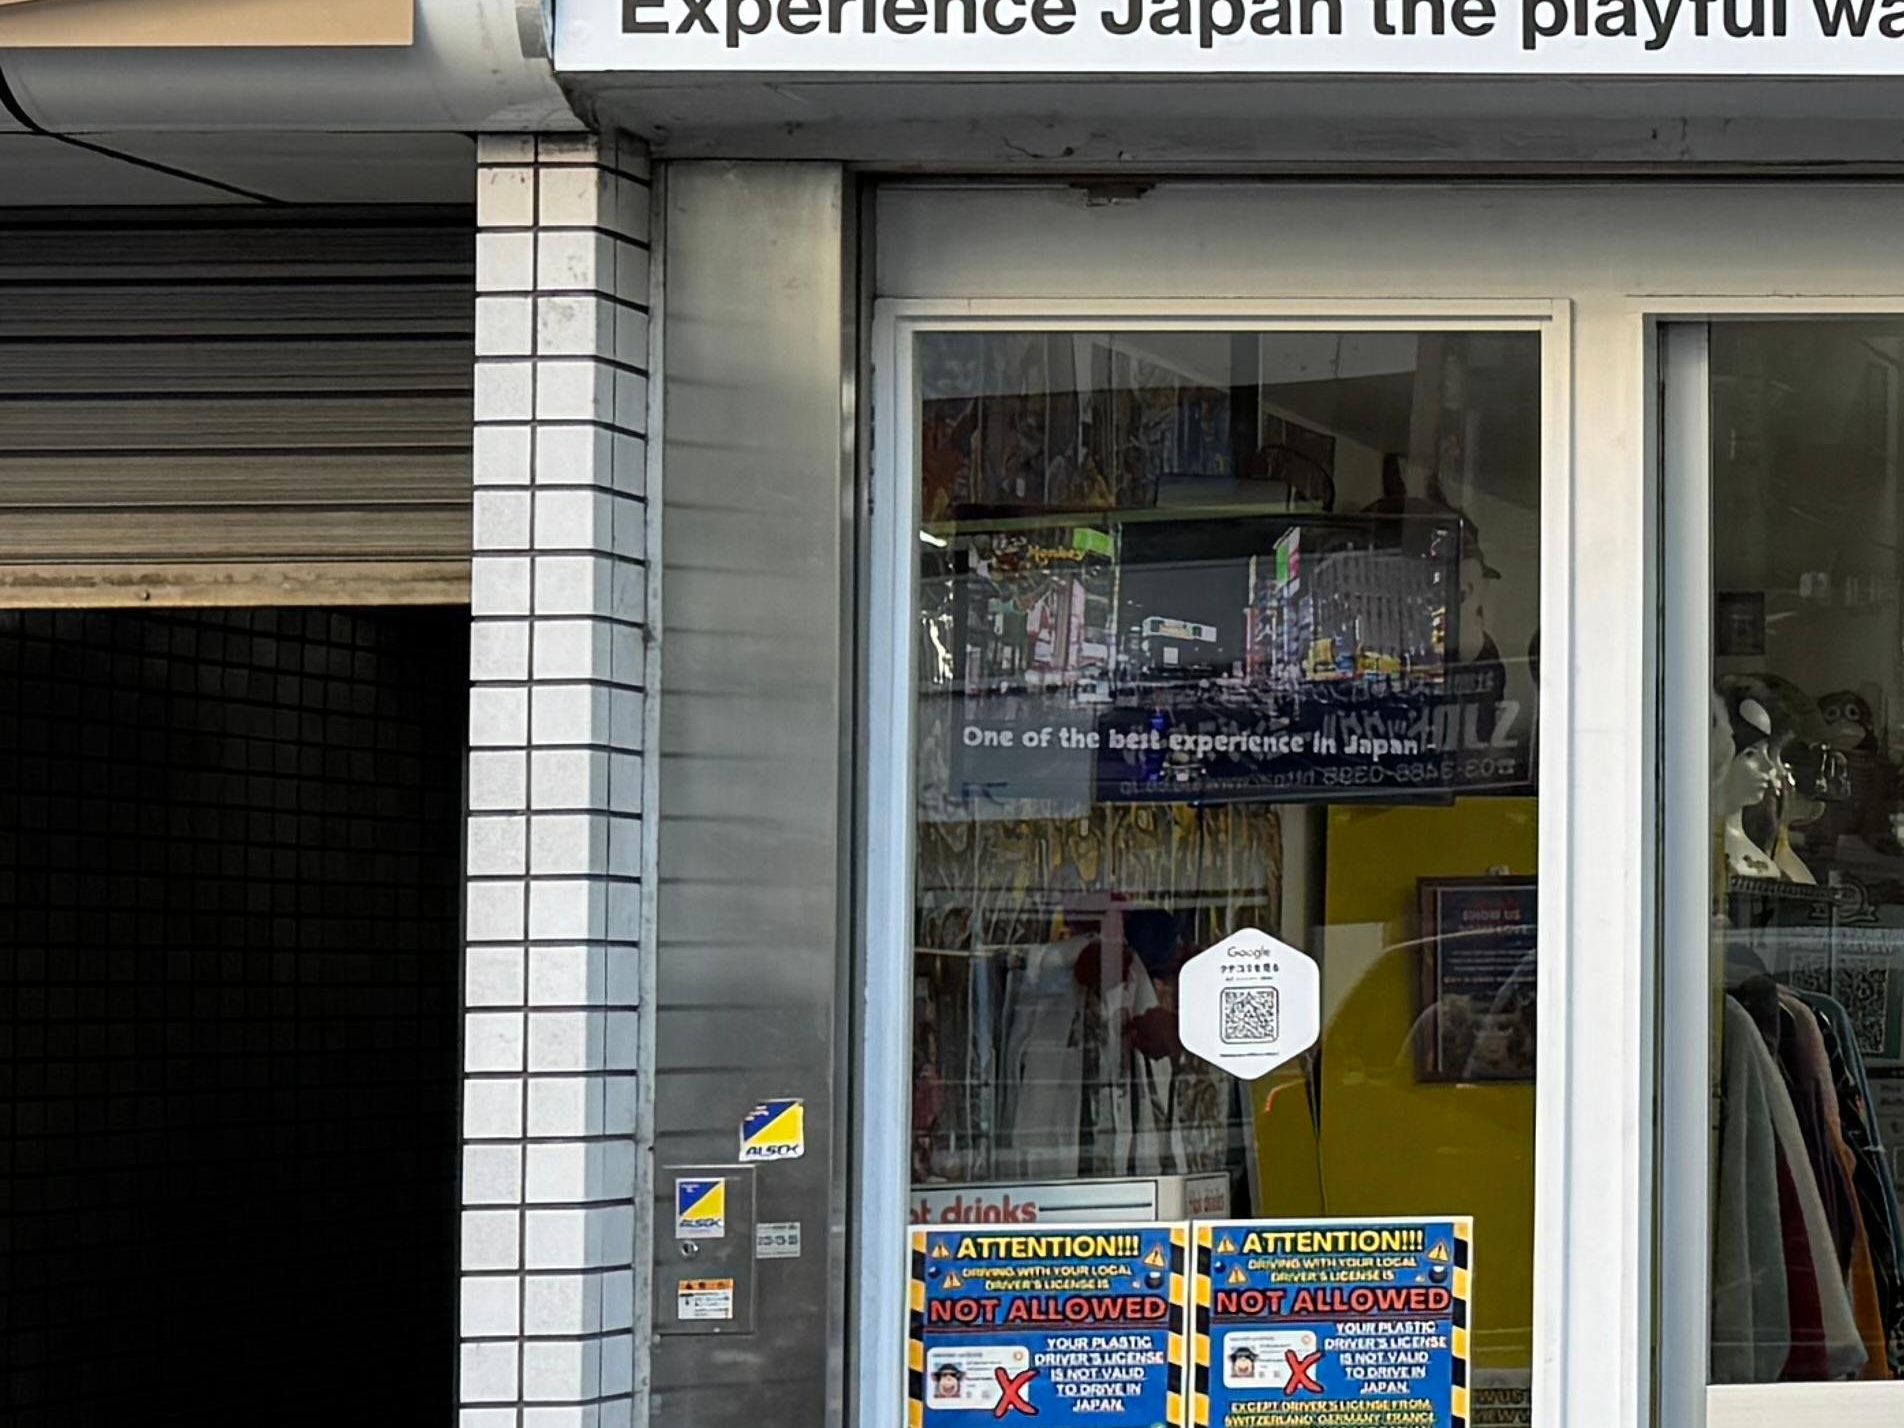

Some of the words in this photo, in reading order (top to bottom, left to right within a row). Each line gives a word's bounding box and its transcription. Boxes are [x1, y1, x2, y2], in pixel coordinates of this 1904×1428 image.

[962, 726, 1013, 748] One
[1022, 727, 1055, 748] of
[1059, 727, 1100, 749] the
[1109, 728, 1161, 751] best
[1169, 728, 1304, 755] experience
[1314, 731, 1337, 754] in
[1344, 735, 1418, 760] Japan
[1227, 945, 1271, 960] Google
[745, 1144, 799, 1157] ALSOK
[951, 1195, 1038, 1223] drinks
[957, 1235, 1140, 1259] ATTENTION!!!
[1242, 1230, 1423, 1254] ATTENTION!!!
[1302, 1258, 1335, 1269] WITH
[1338, 1257, 1374, 1268] YOUR
[1376, 1256, 1417, 1267] LOCAL
[963, 1267, 1015, 1277] DRIVING
[1017, 1266, 1049, 1277] WITH
[1053, 1265, 1089, 1276] YOUR
[1091, 1264, 1132, 1276] LOCAL
[1382, 1271, 1394, 1280] IS
[1045, 1279, 1096, 1290] LICENSE
[1097, 1279, 1109, 1289] IS
[1216, 1290, 1284, 1313] NOT
[1293, 1288, 1450, 1312] ALLOWED
[930, 1299, 999, 1322] NOT
[1008, 1296, 1166, 1320] ALLOWED
[1336, 1322, 1376, 1335] YOUR
[1378, 1321, 1437, 1334] PLASTIC
[1047, 1338, 1088, 1350] YOUR
[1092, 1336, 1152, 1349] PLASTIC
[1324, 1338, 1388, 1351] DRIVER'S
[1390, 1336, 1447, 1349] LICENSE
[1034, 1353, 1101, 1365] DRIVER'S
[1104, 1352, 1164, 1364] LICENSE
[1340, 1353, 1352, 1365] IS
[1354, 1352, 1385, 1364] NOT
[1387, 1351, 1429, 1363] VALID
[1050, 1369, 1064, 1381] IS
[1067, 1368, 1099, 1380] NOT
[1101, 1367, 1145, 1379] VALID
[1345, 1367, 1366, 1379] TO
[1369, 1366, 1409, 1379] DRIVE
[1411, 1366, 1426, 1378] IN
[1056, 1385, 1078, 1396] TO
[1082, 1384, 1123, 1396] DRIVE
[1126, 1383, 1141, 1395] IN
[1392, 1399, 1432, 1410] FROM
